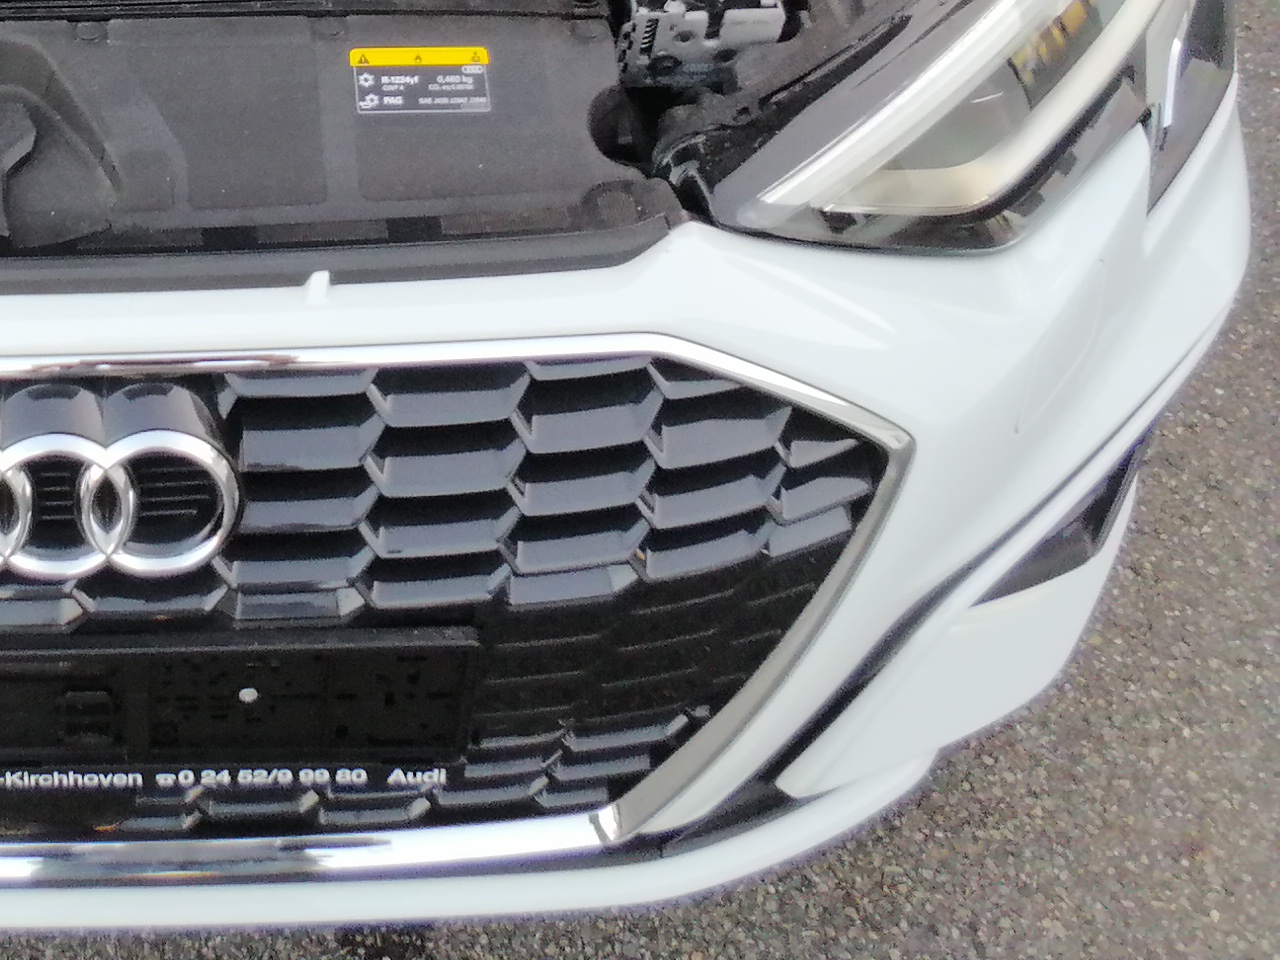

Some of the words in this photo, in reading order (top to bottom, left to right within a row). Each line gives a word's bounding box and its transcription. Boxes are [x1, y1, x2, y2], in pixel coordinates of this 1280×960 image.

[178, 769, 195, 785] 0
[200, 769, 231, 785] 24
[387, 768, 447, 785] Audi
